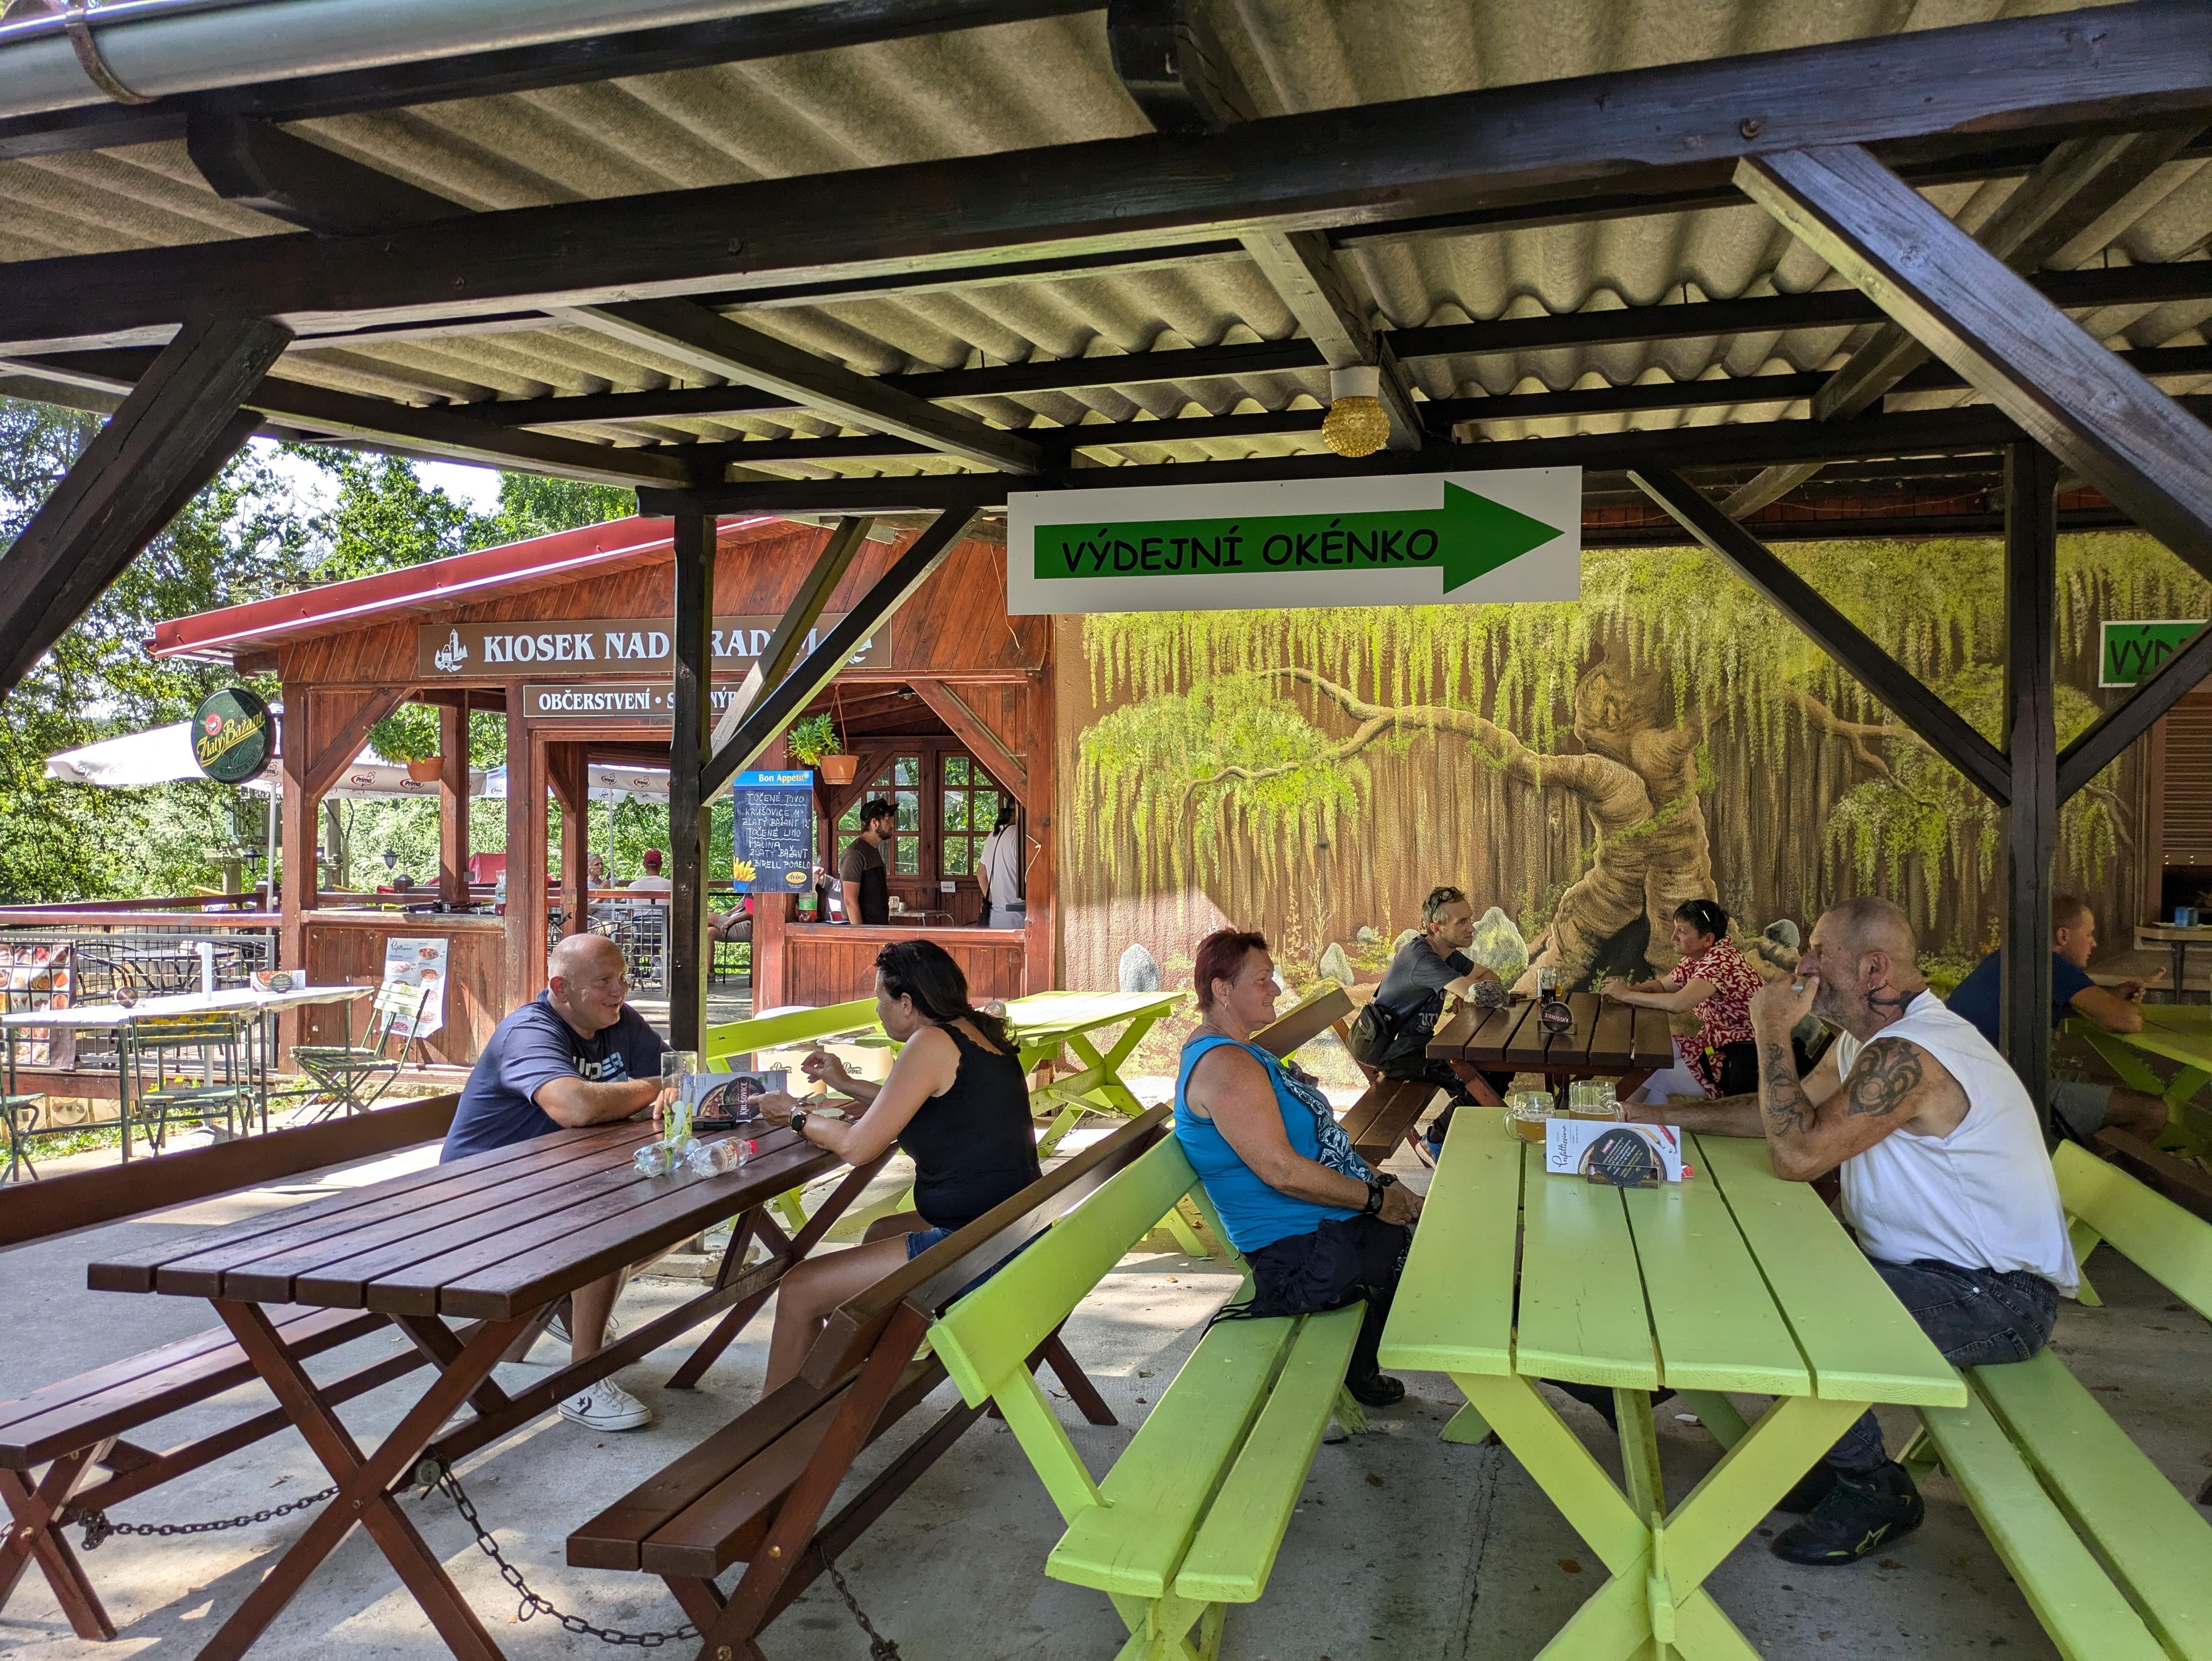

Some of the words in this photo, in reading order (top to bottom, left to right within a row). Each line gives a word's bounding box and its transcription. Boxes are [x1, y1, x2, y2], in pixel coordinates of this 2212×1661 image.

[1062, 524, 1244, 573] VÝDEJNÍ
[1262, 518, 1439, 566] OKÉNKO
[483, 633, 596, 663] KIOSEK
[604, 632, 670, 659] NAD
[538, 687, 651, 711] OBČERSTVENÍ
[196, 733, 226, 767] Zlatý
[223, 710, 265, 747] Bažant
[758, 774, 774, 782] Bon
[747, 792, 781, 803] TOČENÉ
[785, 794, 805, 803] PIVO
[745, 805, 790, 817] KRUŠOVICE
[742, 816, 768, 827] ZLATÝ
[746, 826, 779, 837] TOČENÉ
[784, 828, 801, 838] LIMO
[748, 840, 781, 849] MALINA
[749, 847, 777, 858] ZLATÝ
[778, 845, 808, 859] BAŽANT
[753, 859, 781, 869] BIRELL
